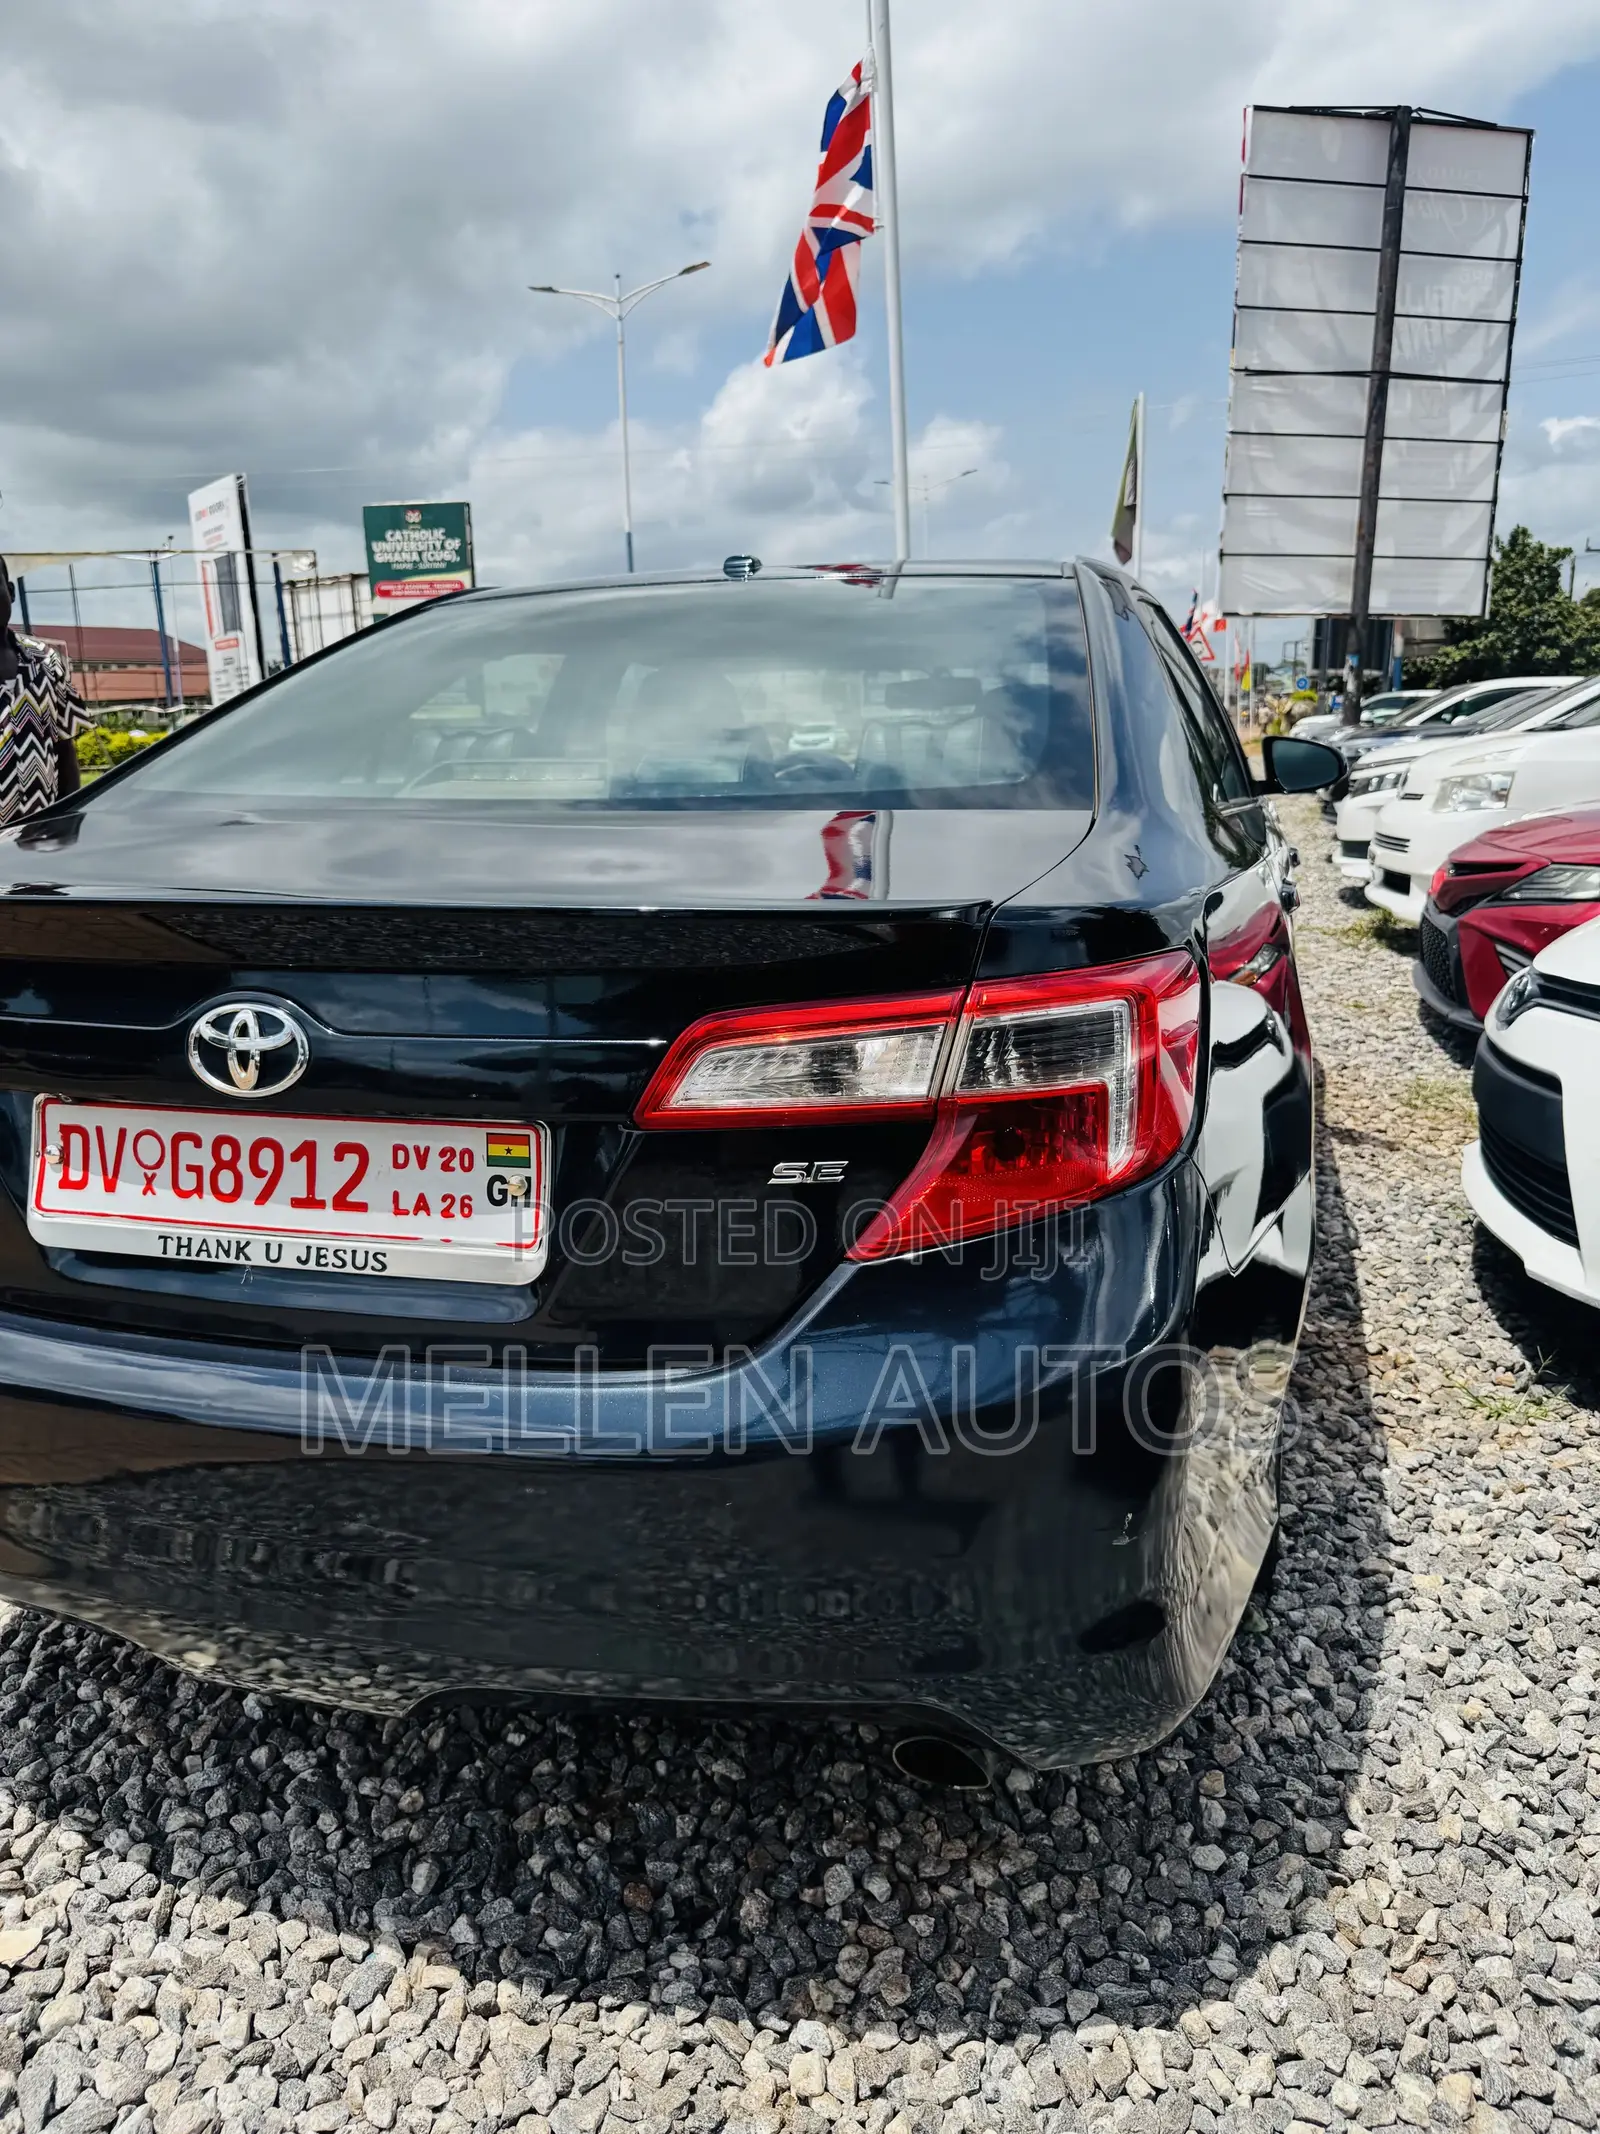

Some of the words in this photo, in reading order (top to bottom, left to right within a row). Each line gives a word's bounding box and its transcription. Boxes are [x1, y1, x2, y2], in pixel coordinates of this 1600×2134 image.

[371, 540, 443, 553] UNIVERSITY
[443, 537, 461, 551] OF
[385, 528, 446, 541] CATHOLIC
[373, 551, 420, 563] GHANA
[392, 1143, 430, 1171] DV
[438, 1146, 475, 1173] 20
[766, 1160, 849, 1185] SE
[392, 1190, 431, 1217] LA
[440, 1193, 473, 1219] 26
[158, 1235, 251, 1262] THANK
[265, 1242, 283, 1264] U
[296, 1245, 388, 1273] JESUS
